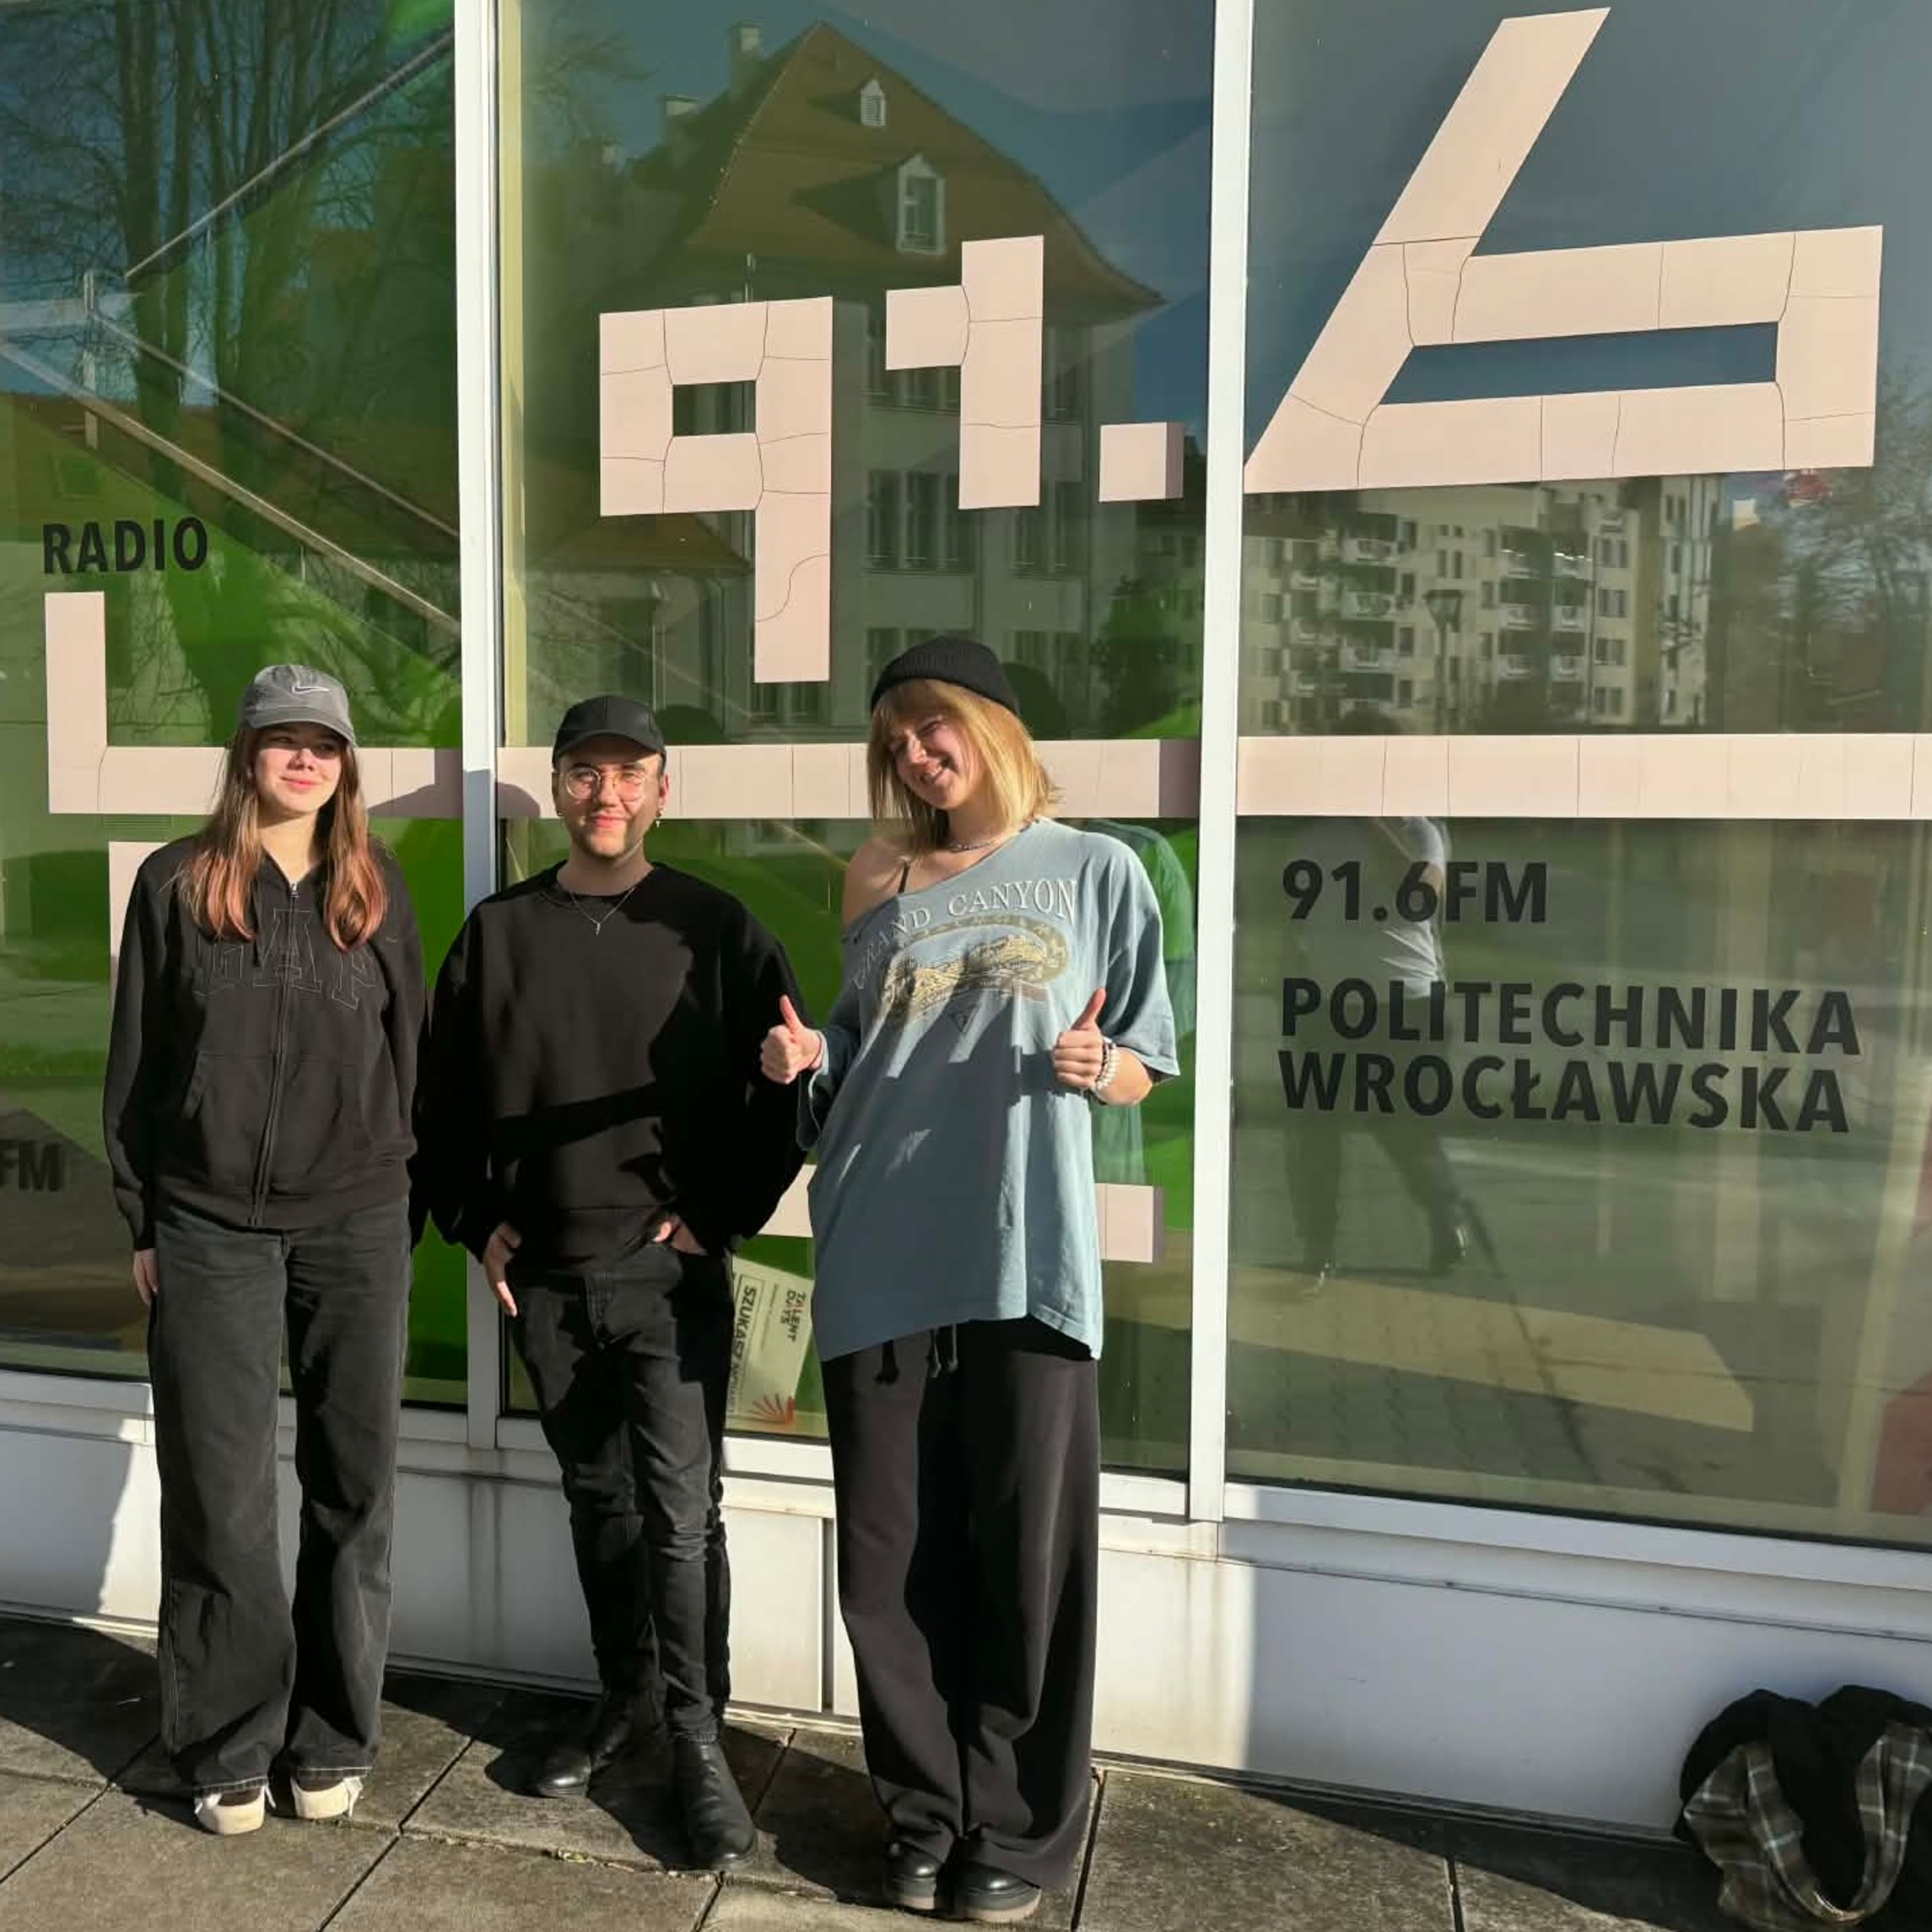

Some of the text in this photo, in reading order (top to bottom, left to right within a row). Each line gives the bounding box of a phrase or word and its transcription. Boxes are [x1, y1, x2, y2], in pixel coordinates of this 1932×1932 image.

[43, 517, 208, 574] RADIO
[949, 877, 1079, 925] CANYON
[1283, 860, 1548, 923] 91.6FM
[1282, 978, 1862, 1055] POLITECHNIKA
[1279, 1051, 1850, 1133] WROCŁAWSKA
[781, 1291, 797, 1325] DAYS
[787, 1291, 806, 1343] TALENT
